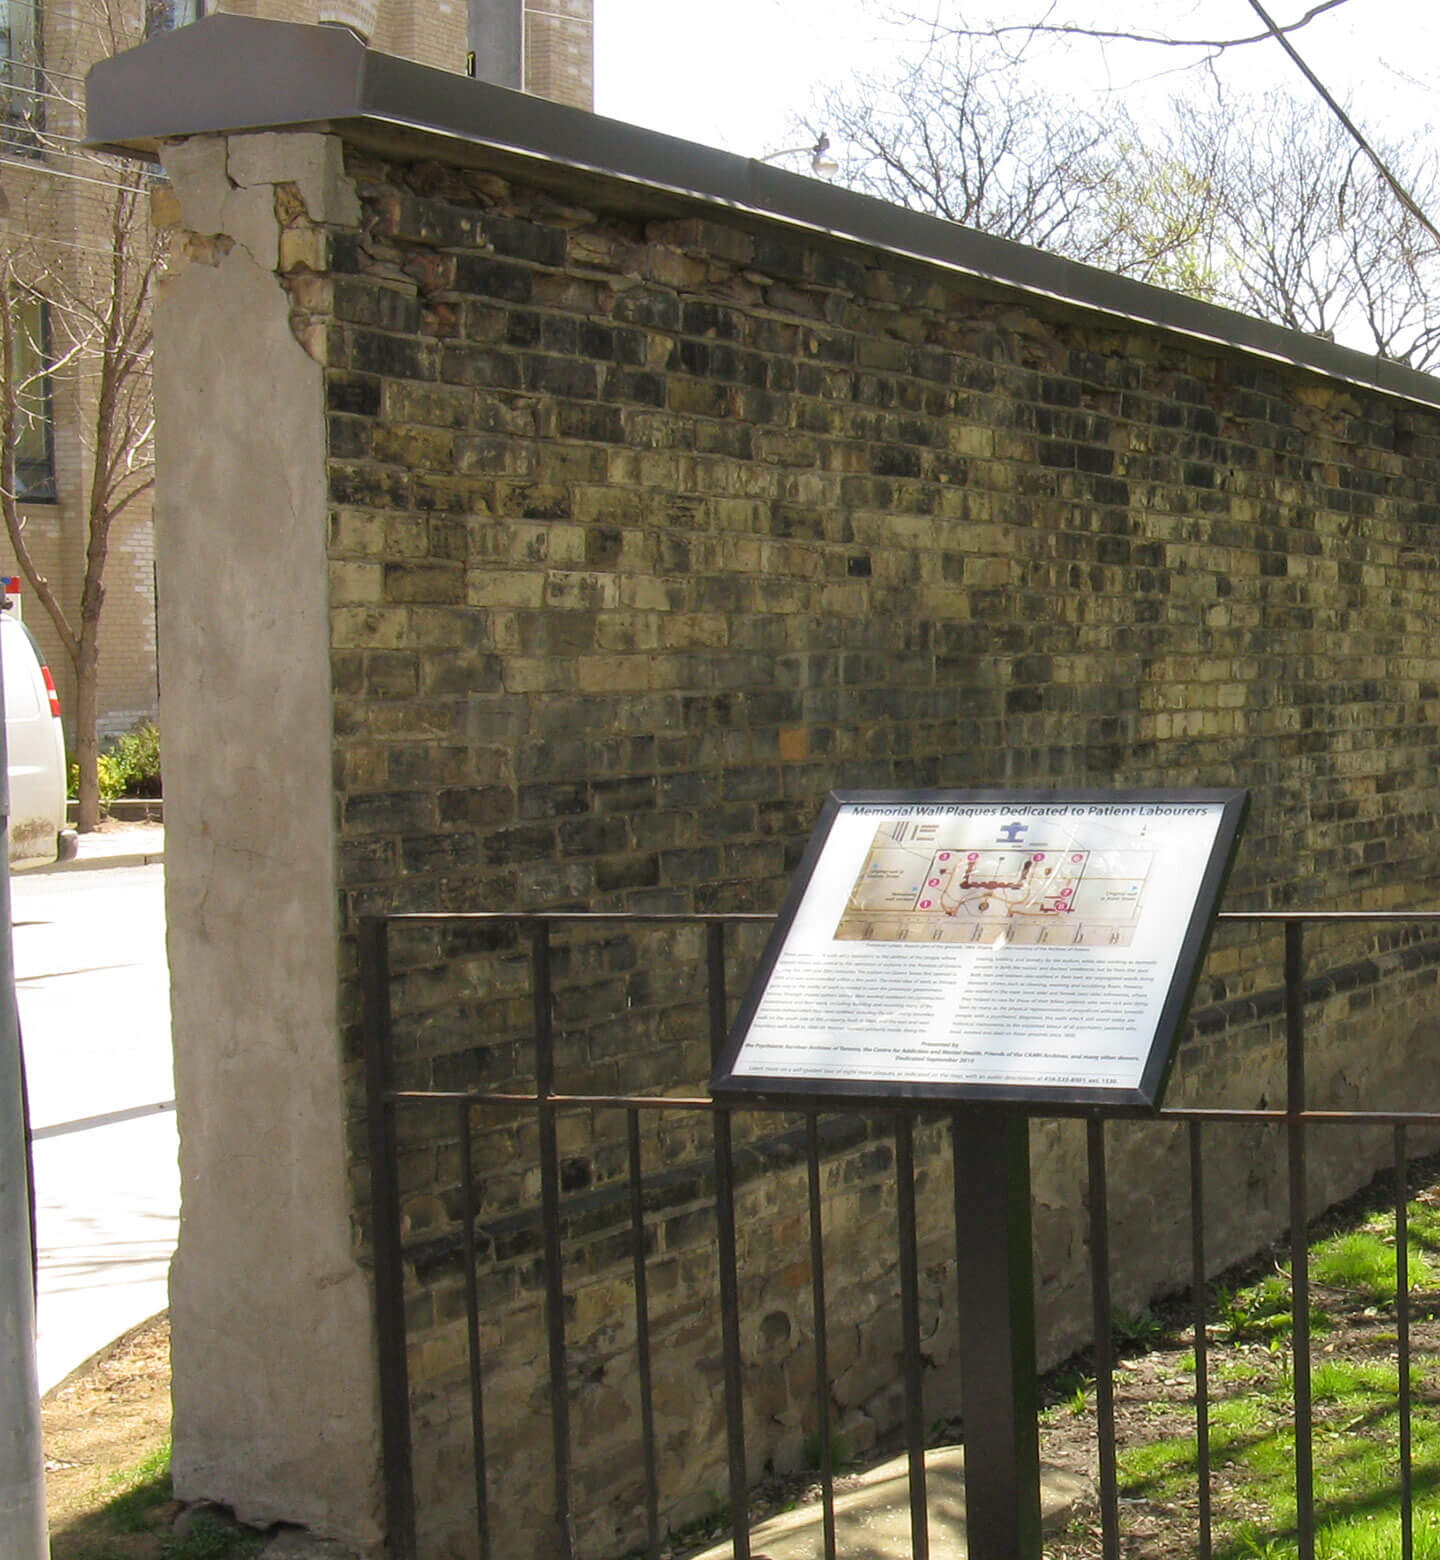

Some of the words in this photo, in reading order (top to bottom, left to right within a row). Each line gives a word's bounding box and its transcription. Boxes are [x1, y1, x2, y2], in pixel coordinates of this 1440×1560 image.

[852, 805, 913, 817] Memorial
[916, 805, 942, 817] Wall
[945, 805, 997, 819] Plaques
[1000, 805, 1067, 817] Dedicated
[1071, 806, 1085, 817] to
[1088, 805, 1136, 817] Patient
[1139, 806, 1208, 817] Labourers
